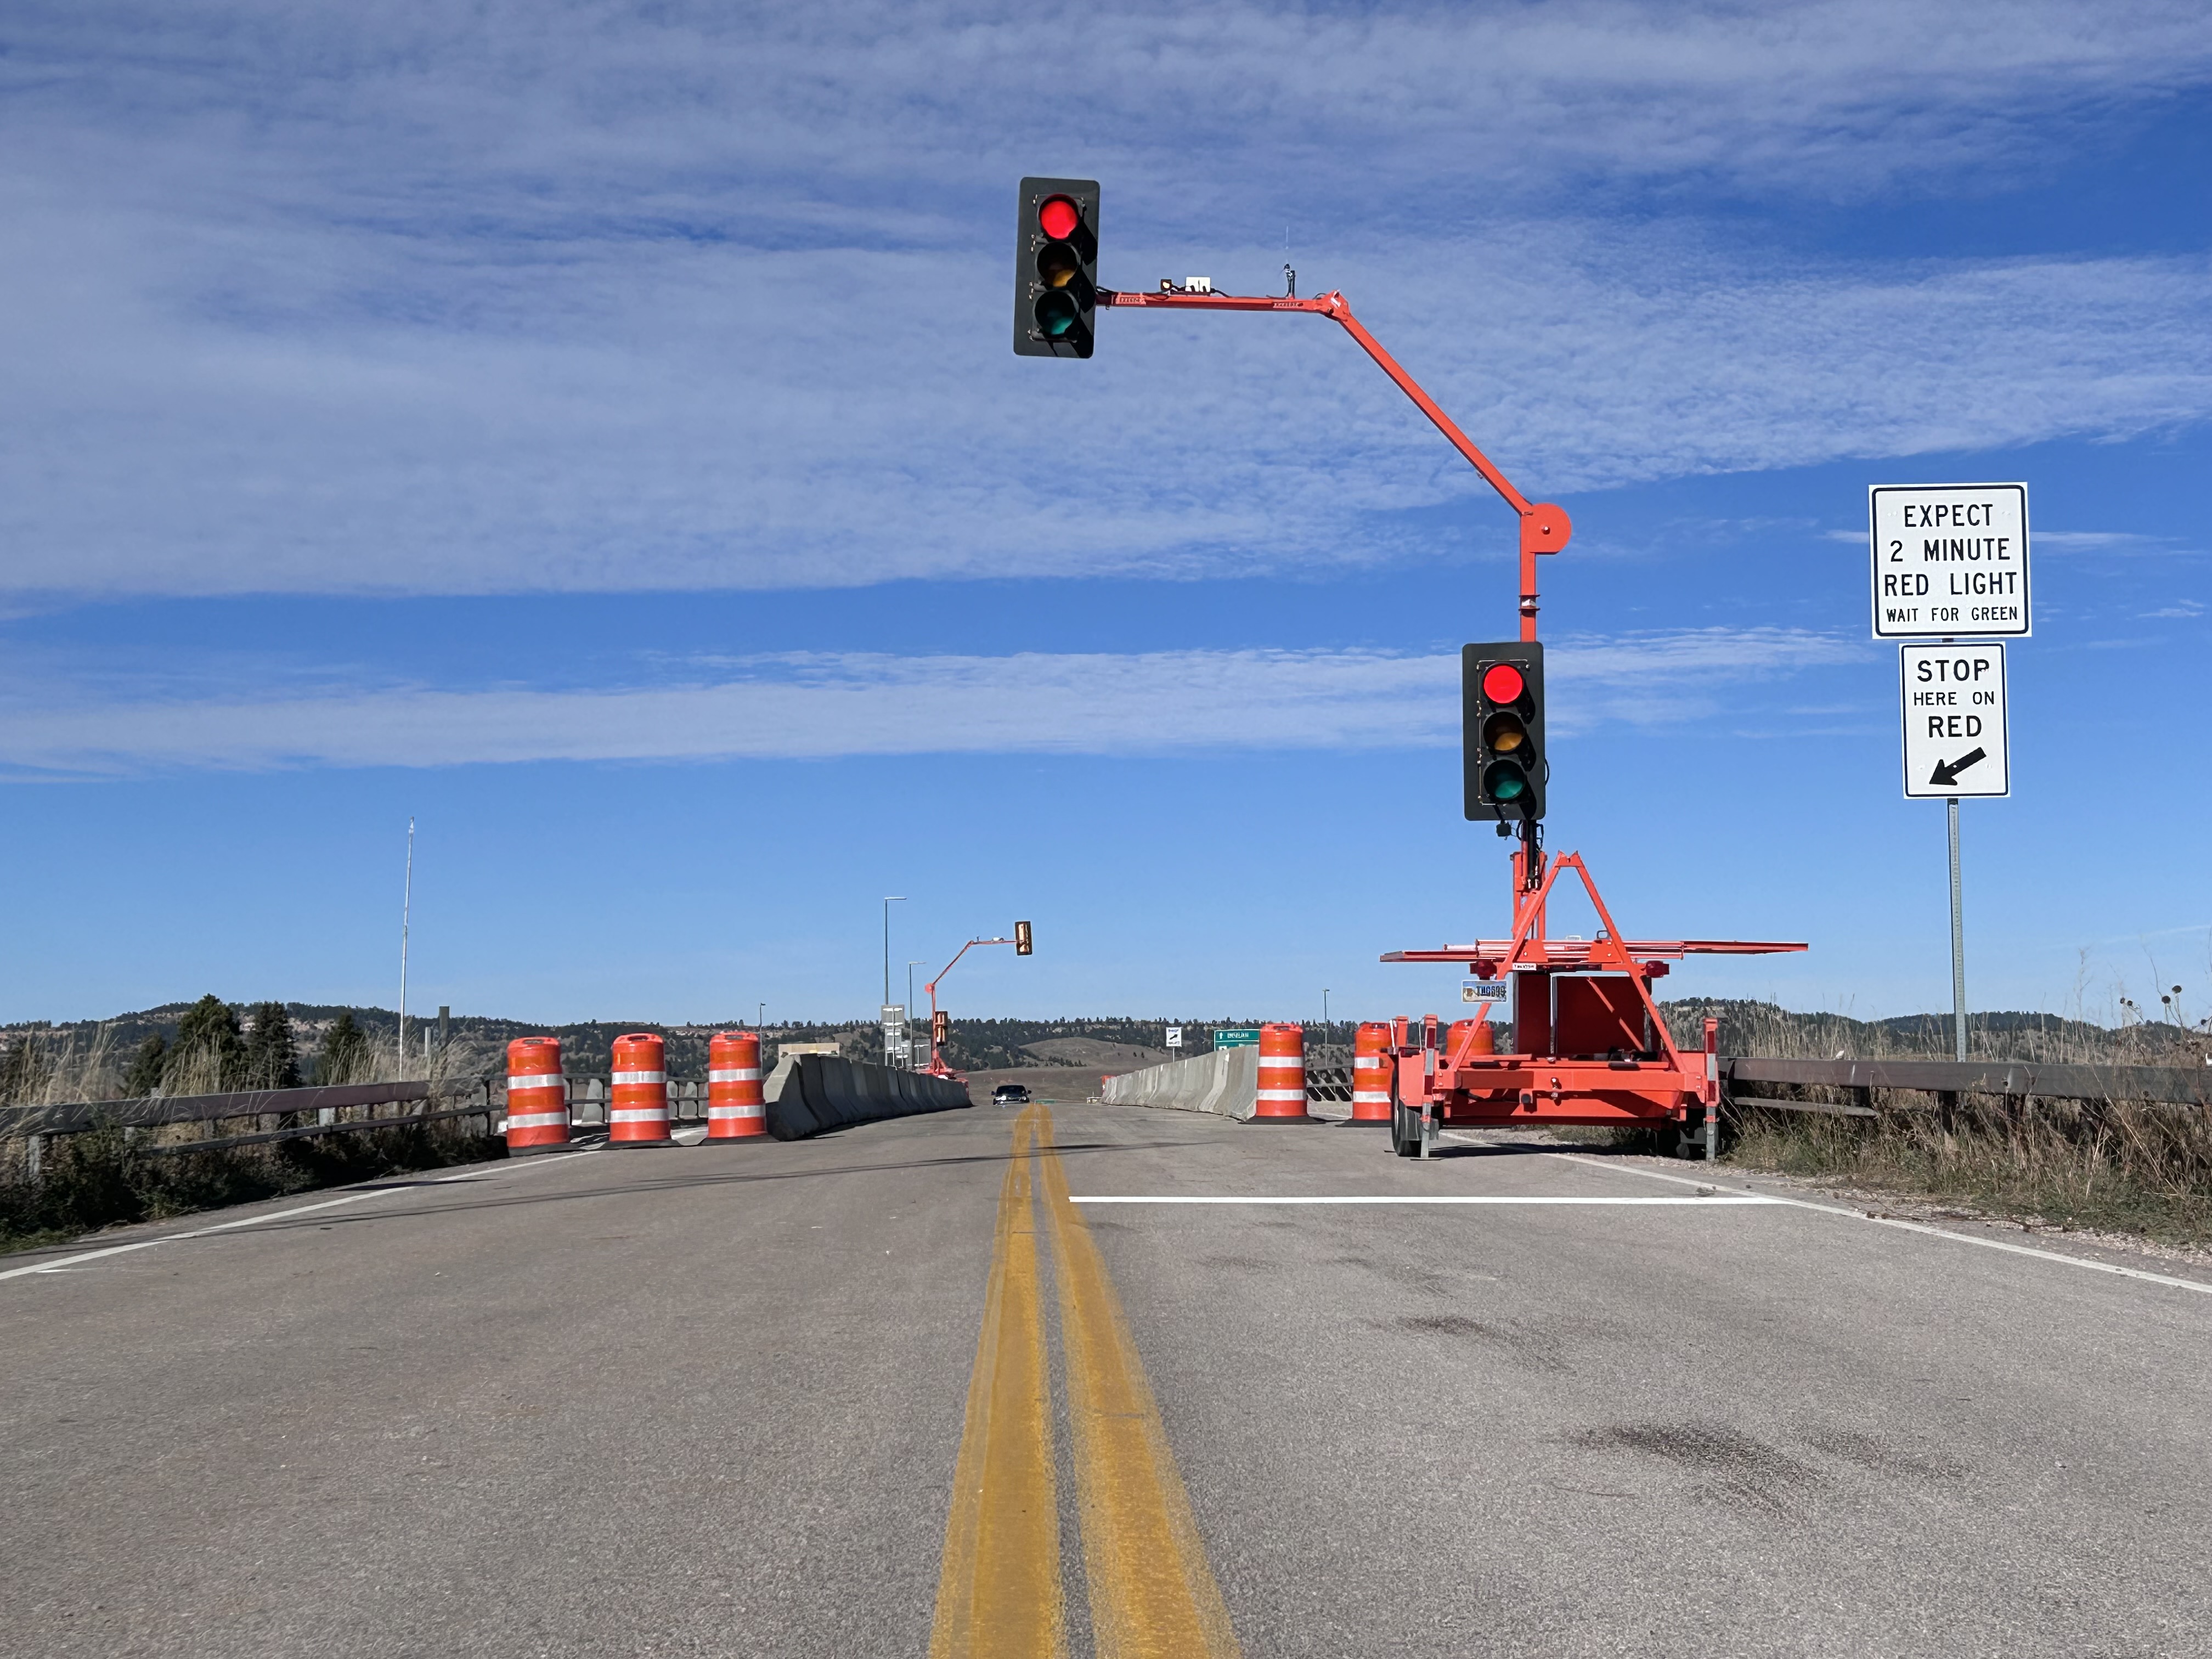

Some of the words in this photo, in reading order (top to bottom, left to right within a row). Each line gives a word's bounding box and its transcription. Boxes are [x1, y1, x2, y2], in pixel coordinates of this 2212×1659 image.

[1904, 504, 1993, 527] EXPECT
[1890, 540, 1903, 562] 2
[1924, 538, 2010, 562] MINUTE
[1884, 574, 1929, 596] RED
[1950, 572, 2017, 595] LIGHT
[1886, 608, 1918, 622] WAIT
[1931, 607, 1959, 622] FOR
[1971, 606, 2017, 620] GREEN
[1917, 659, 1990, 682] STOP
[1914, 691, 1957, 706] HERE
[1972, 691, 1994, 705] ON
[1928, 715, 1982, 738] RED
